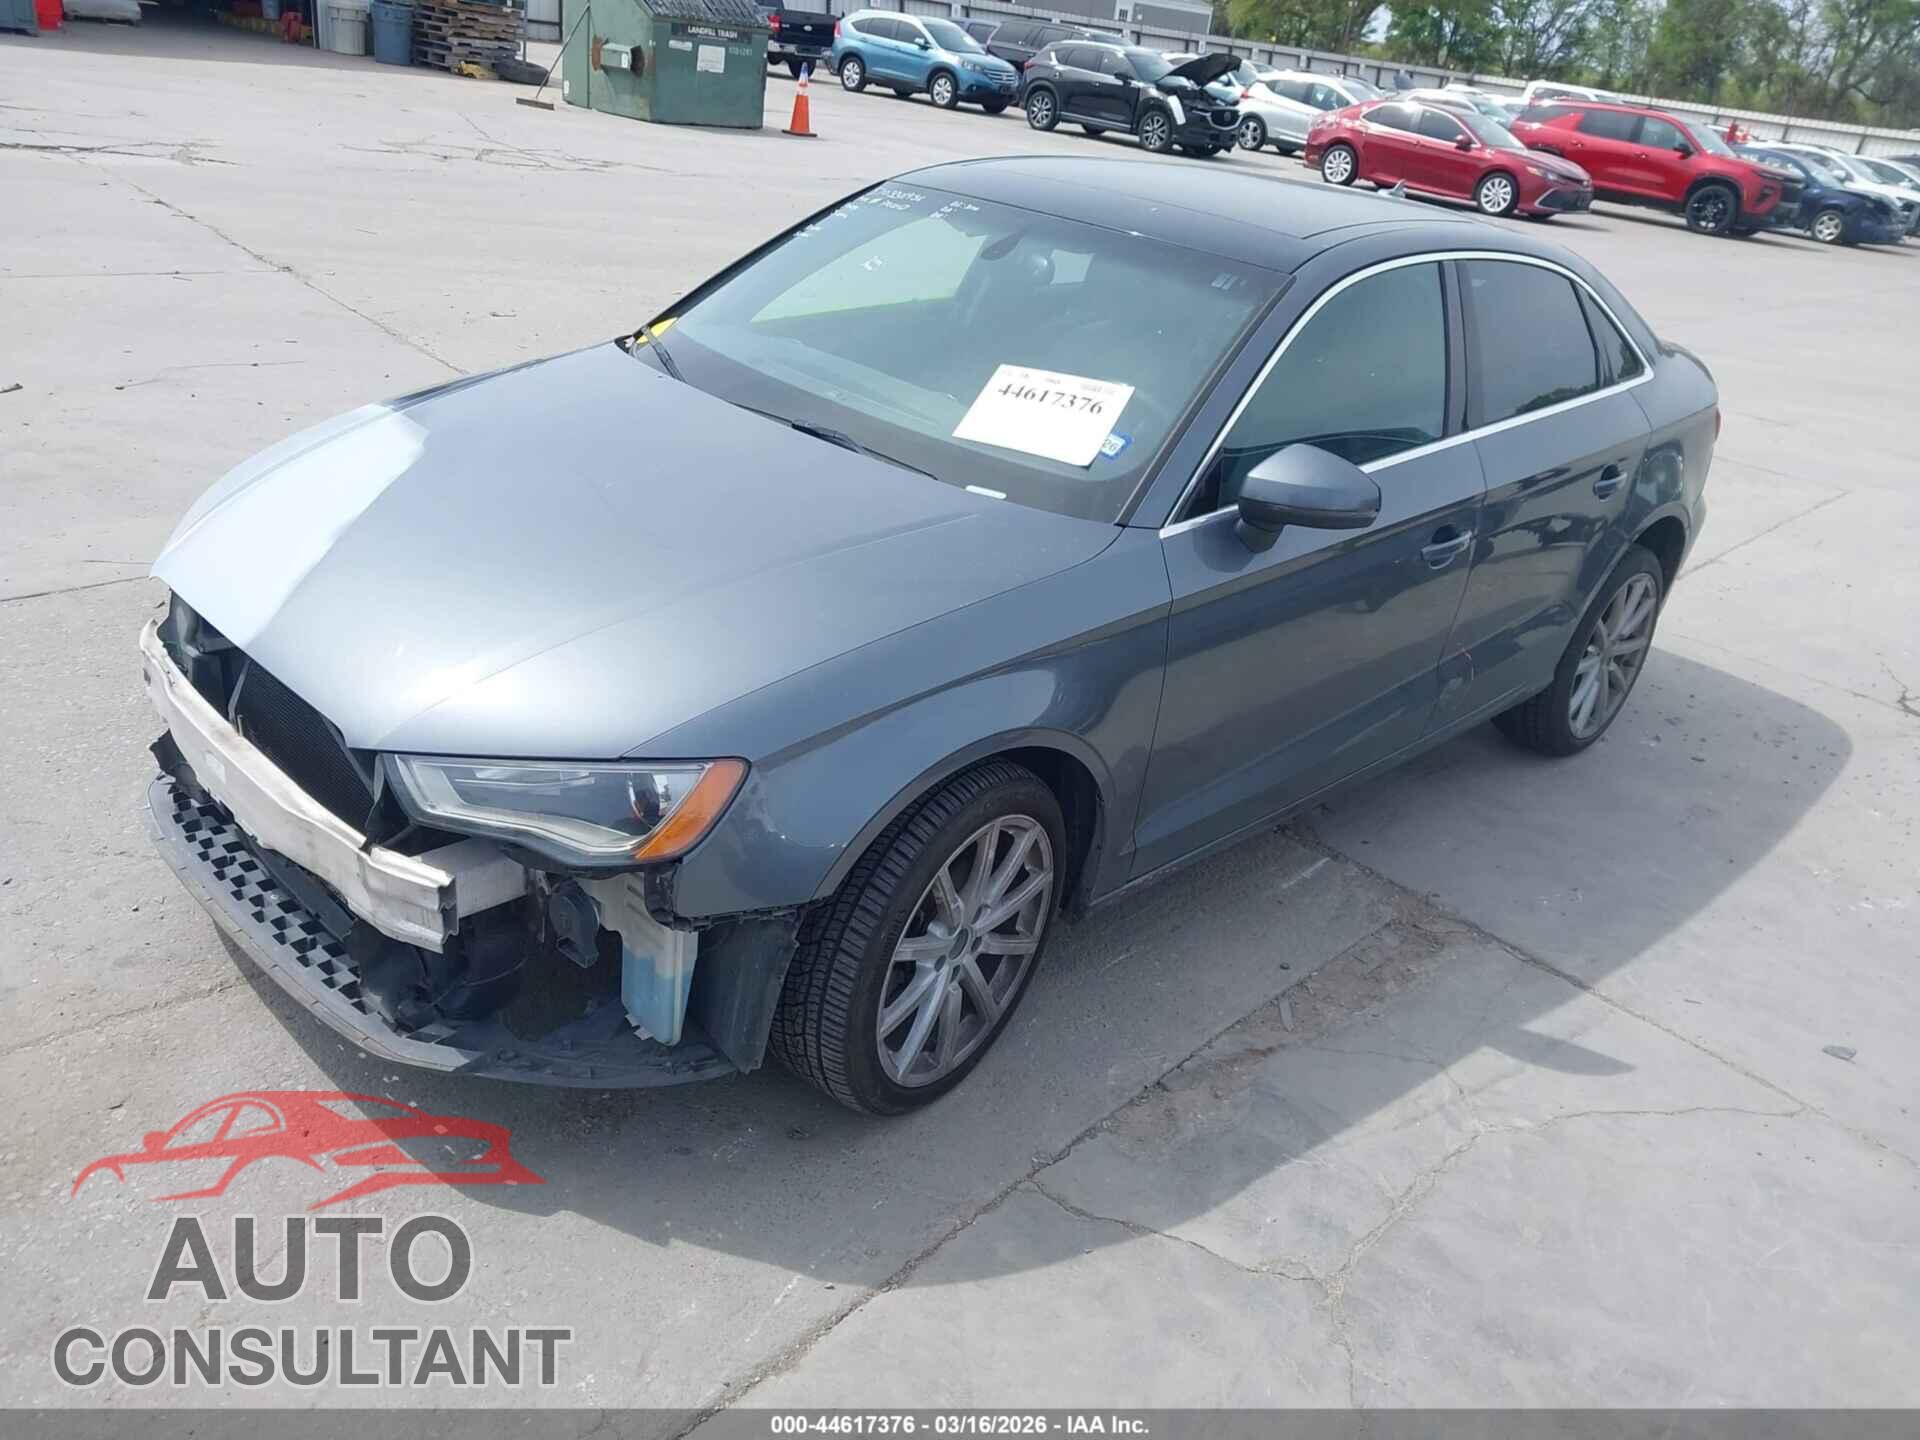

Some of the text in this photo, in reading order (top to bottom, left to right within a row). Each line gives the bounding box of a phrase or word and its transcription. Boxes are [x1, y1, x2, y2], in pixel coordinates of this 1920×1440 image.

[687, 25, 716, 36] LANDFILL
[717, 28, 738, 39] TRASH
[998, 383, 1103, 415] 44617376
